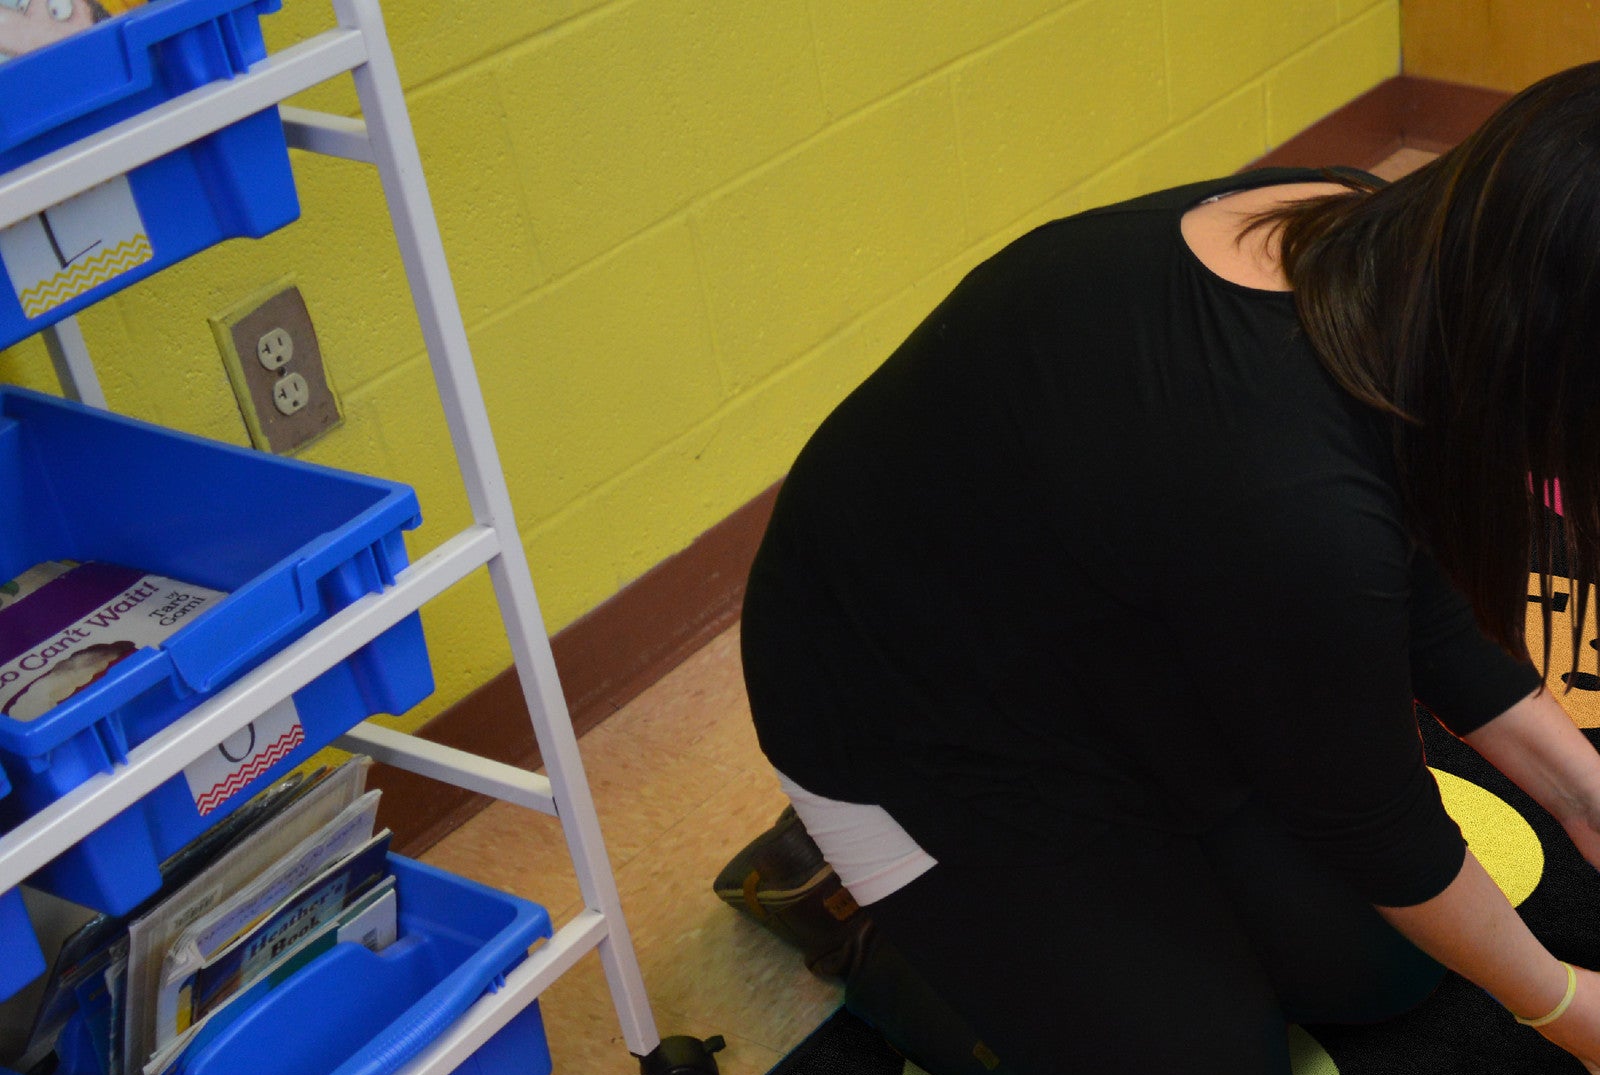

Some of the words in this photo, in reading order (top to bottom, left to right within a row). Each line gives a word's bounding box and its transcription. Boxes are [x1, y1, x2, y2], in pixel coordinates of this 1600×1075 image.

[149, 594, 190, 619] Taro
[159, 596, 206, 627] Gomi
[19, 627, 91, 671] Can't
[86, 581, 160, 628] Wait!
[270, 918, 320, 959] Book
